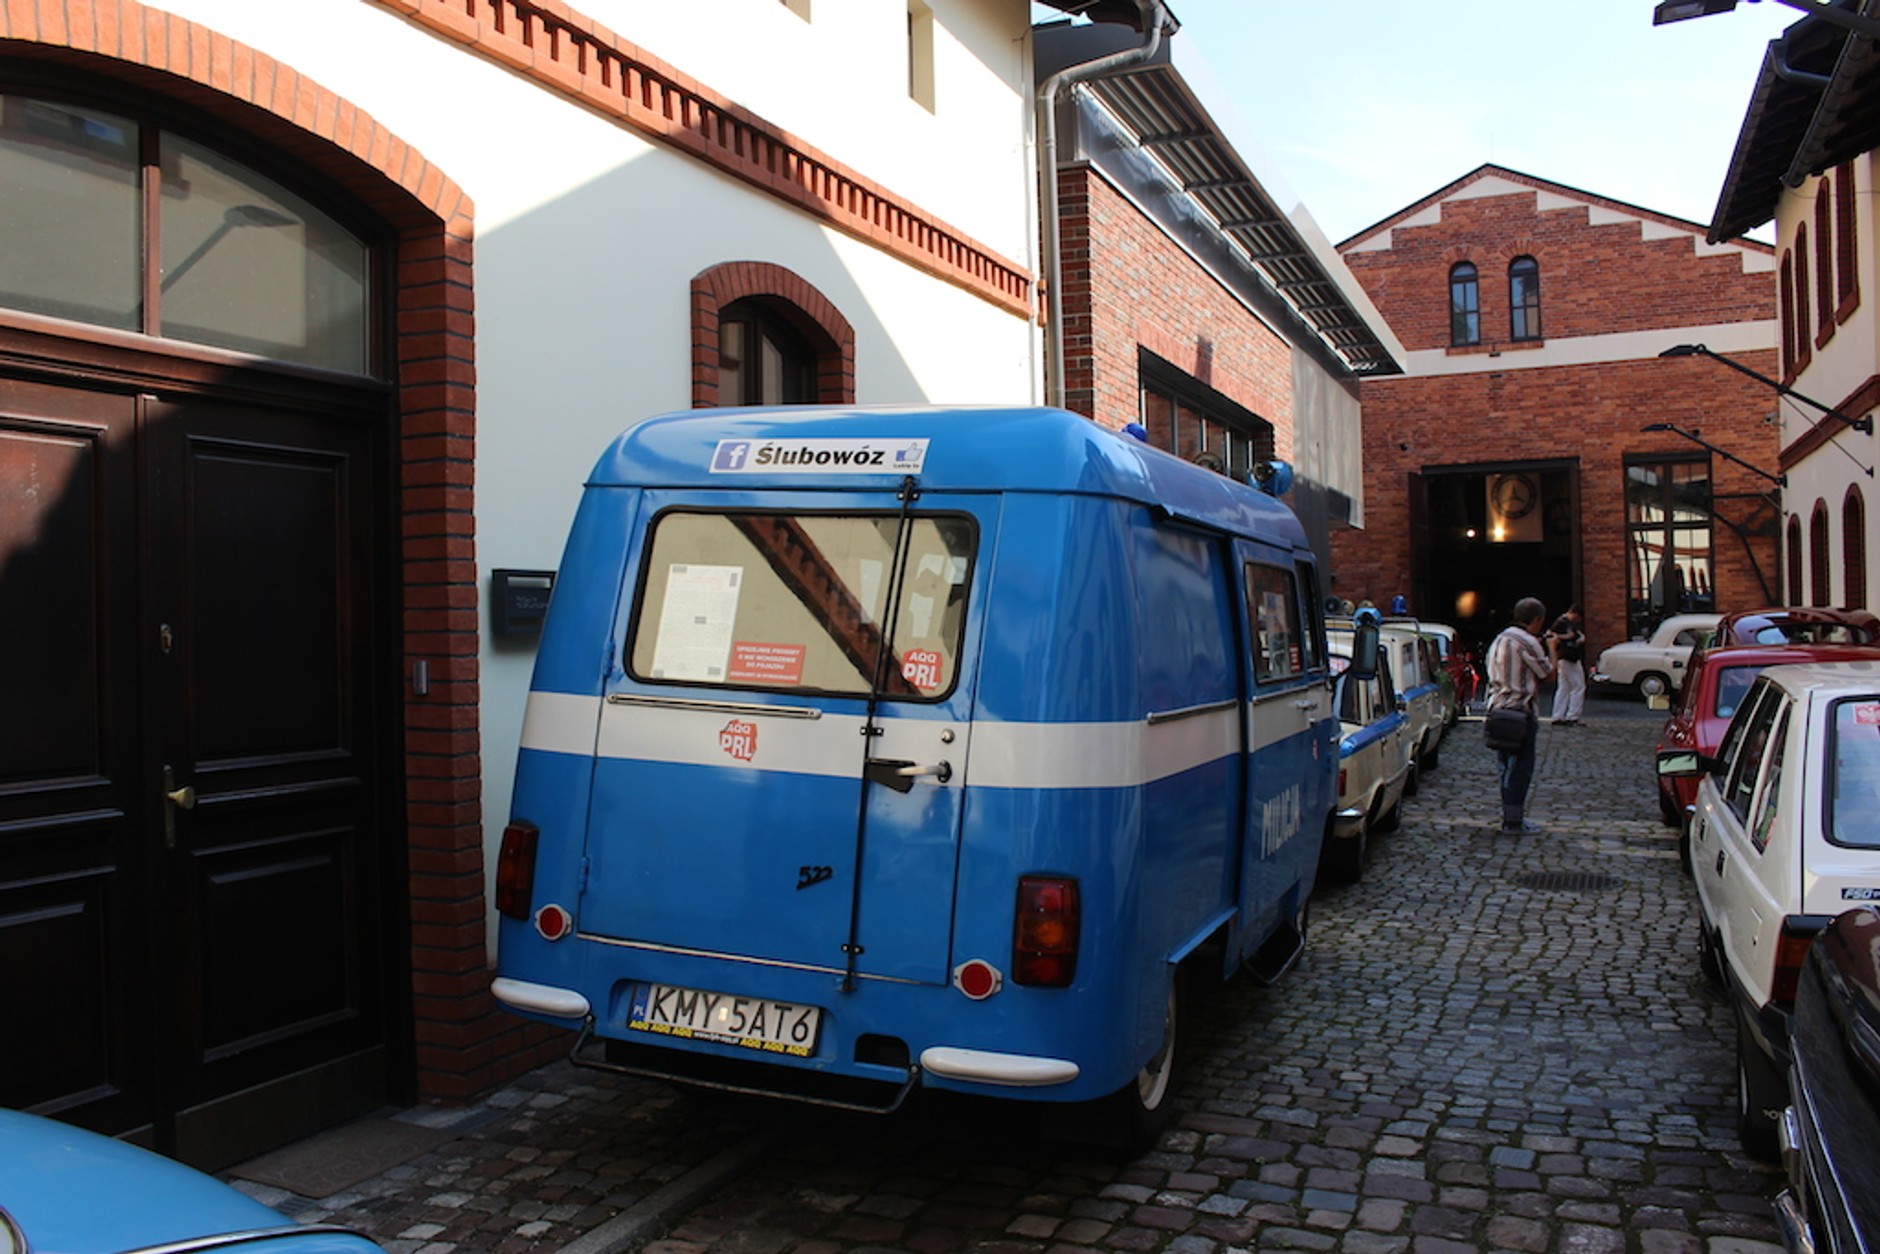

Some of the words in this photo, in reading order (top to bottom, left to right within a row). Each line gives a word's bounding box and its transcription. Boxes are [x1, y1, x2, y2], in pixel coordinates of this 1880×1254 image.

[755, 442, 885, 465] Ślubowóz
[903, 663, 938, 687] PRL
[722, 734, 752, 758] PRL
[633, 1004, 644, 1016] PL
[651, 987, 721, 1029] KMY
[729, 998, 811, 1042] 5AT6
